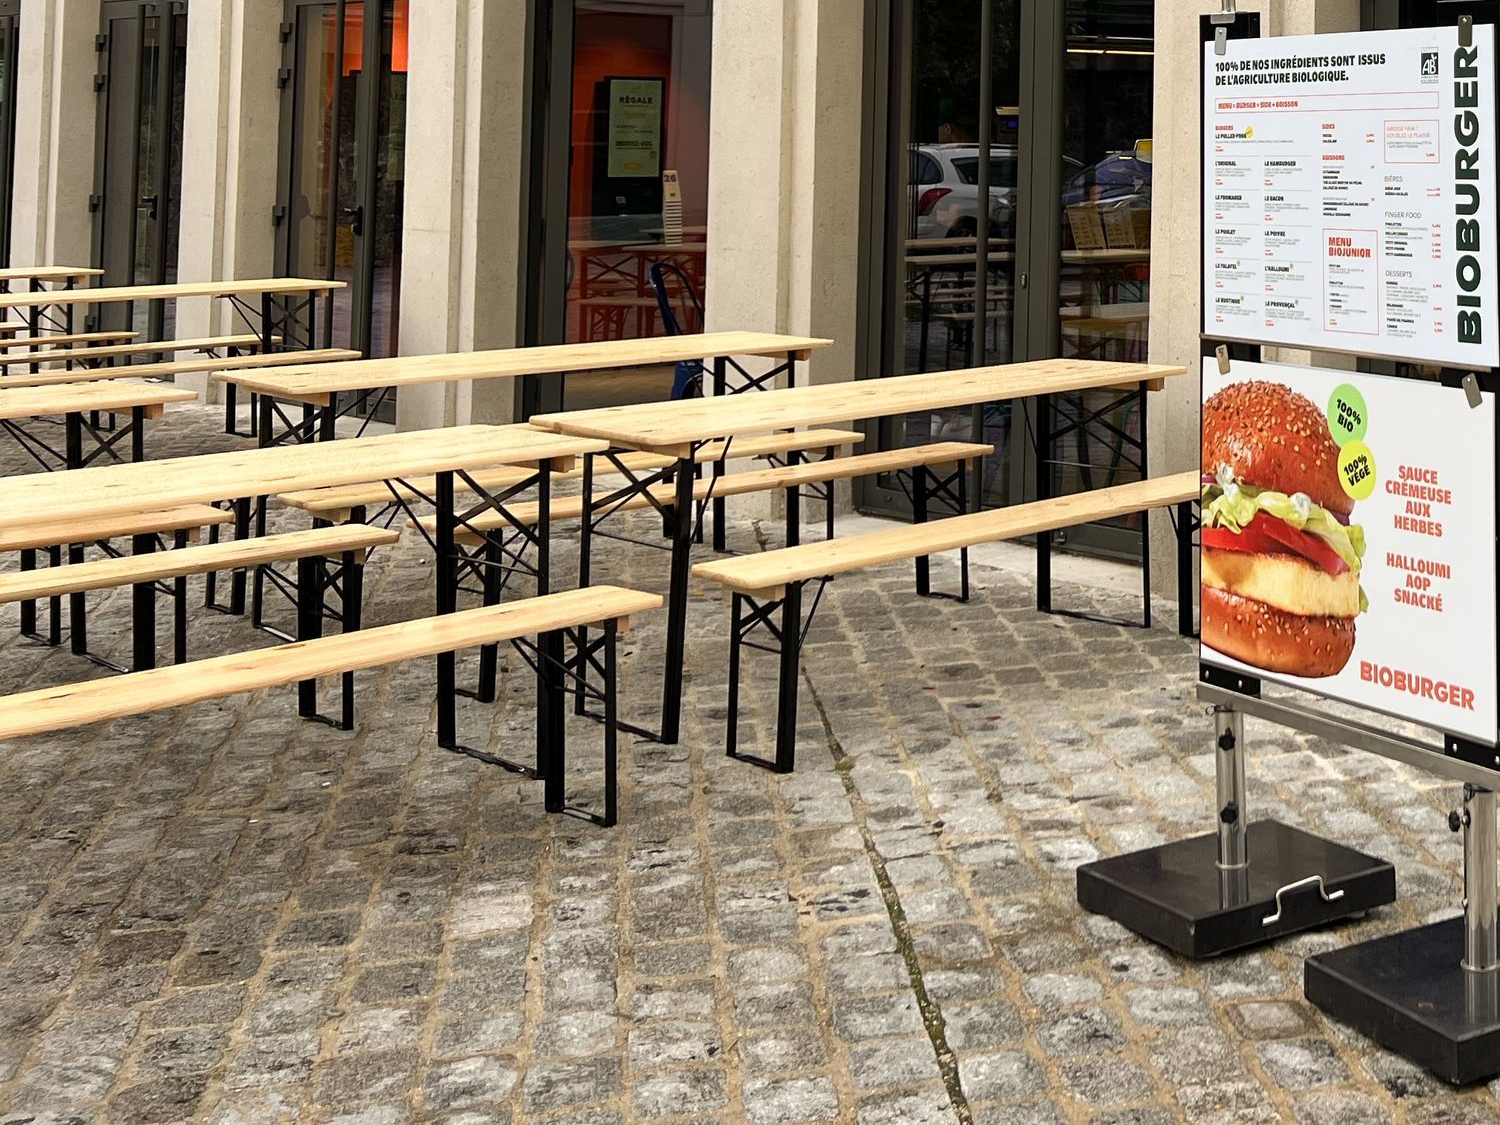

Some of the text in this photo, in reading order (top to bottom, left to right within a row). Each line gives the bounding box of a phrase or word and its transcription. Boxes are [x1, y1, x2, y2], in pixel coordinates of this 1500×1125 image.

[1216, 54, 1385, 72] 100% DE NOS INGRÉDIENTS SONT ISSUS
[1216, 70, 1349, 85] DE L'AGRICULTURE BIOLOGIQUE.
[663, 174, 677, 183] 26
[1454, 46, 1482, 344] BIOBURGER
[1329, 237, 1351, 246] MENU
[1329, 247, 1370, 257] BIOJUNIOR
[1386, 270, 1412, 278] DESSERTS
[1271, 301, 1295, 309] PROVENÇAL
[1336, 398, 1362, 425] 100%
[1337, 413, 1354, 433] BIO
[1344, 453, 1368, 475] 100%
[1348, 465, 1370, 487] VÉGÉ
[1398, 465, 1438, 485] SAUCE
[1385, 475, 1452, 504] CRÉMEUSE
[1405, 501, 1431, 517] AUX
[1394, 515, 1442, 537] HERBES
[1386, 552, 1450, 579] HALLOUMI
[1406, 574, 1431, 591] AOP
[1394, 588, 1442, 611] SNACKÉ
[1360, 660, 1475, 710] BIOBURGER
